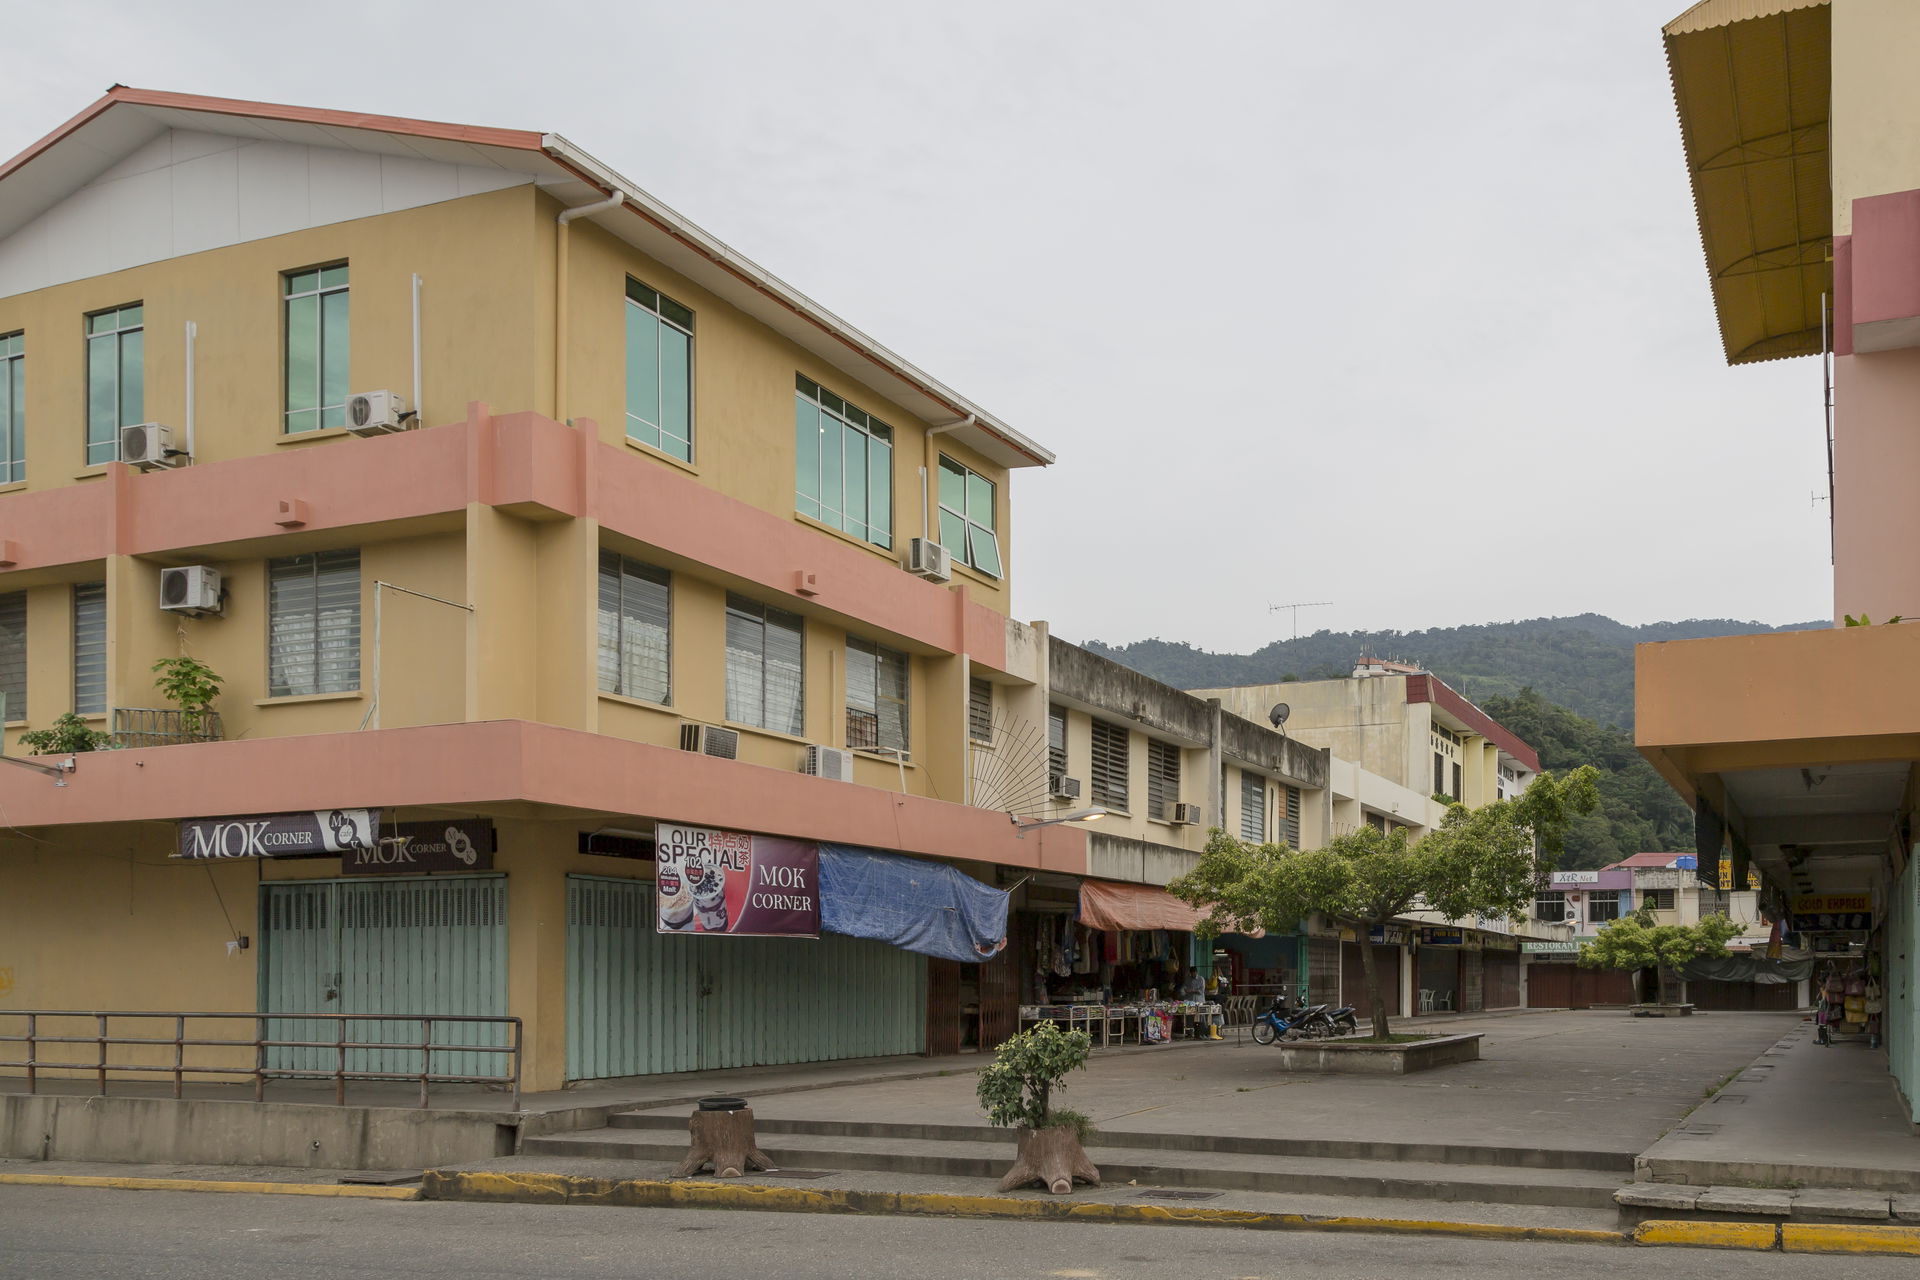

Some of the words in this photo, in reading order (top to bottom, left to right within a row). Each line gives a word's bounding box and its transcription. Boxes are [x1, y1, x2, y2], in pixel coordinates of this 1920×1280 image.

[192, 821, 273, 859] MOK
[264, 831, 313, 846] CORNER
[671, 830, 706, 847] OUR
[354, 836, 416, 865] MOK
[410, 843, 447, 854] CORNER
[659, 843, 744, 872] SPECIAL
[662, 865, 678, 875] 204
[684, 855, 702, 868] 102
[759, 864, 806, 889] MOK
[752, 893, 812, 912] CORNER
[1827, 897, 1867, 910] EXPRESS
